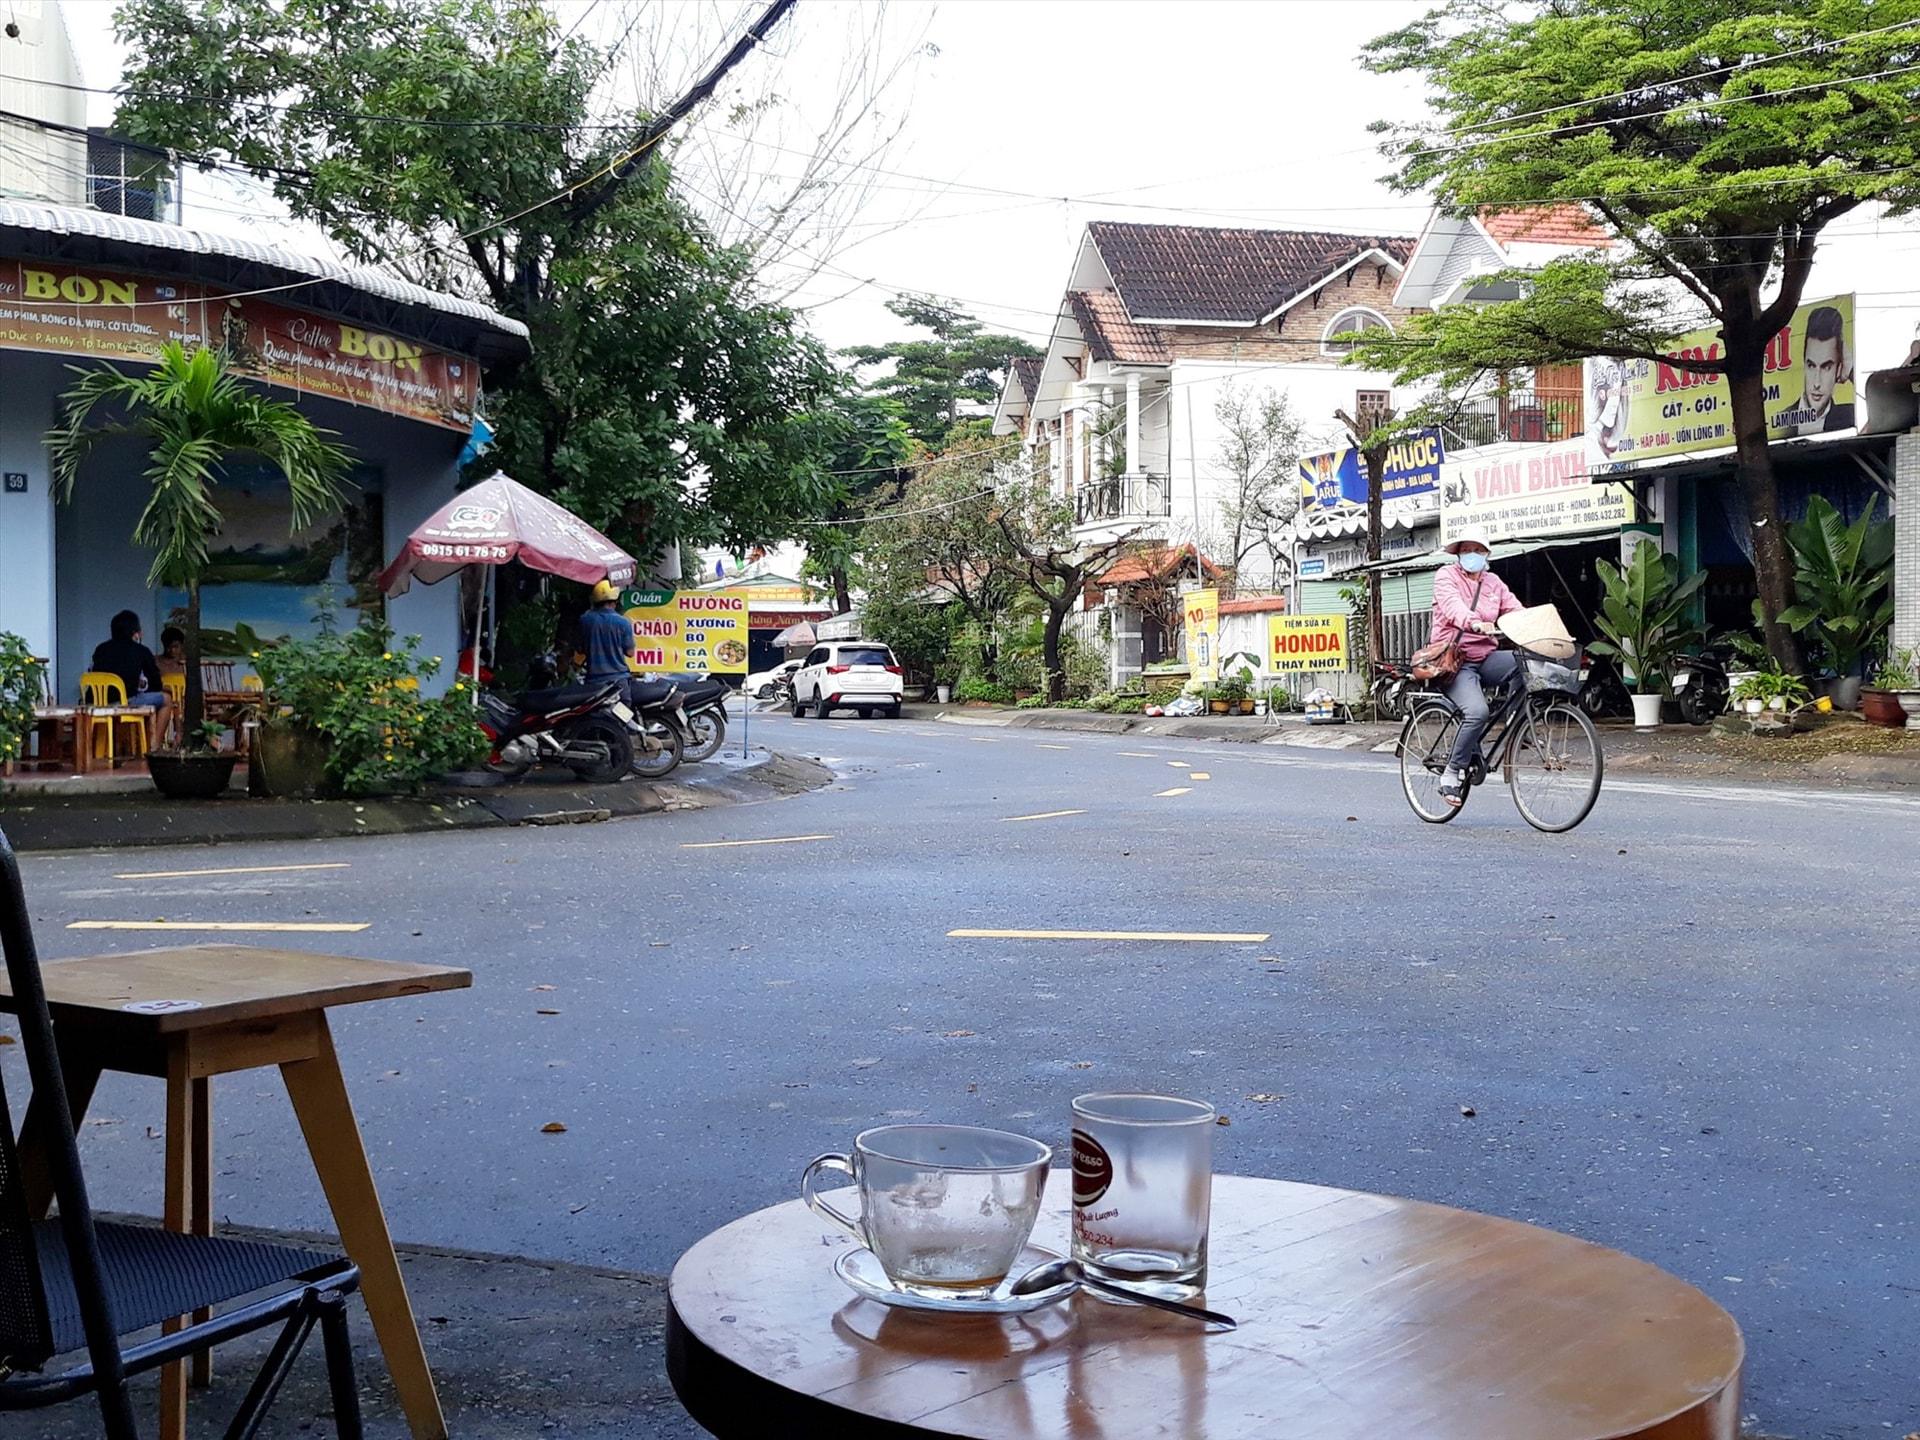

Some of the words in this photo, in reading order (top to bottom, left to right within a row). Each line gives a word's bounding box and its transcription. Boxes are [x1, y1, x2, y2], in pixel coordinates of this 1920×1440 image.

[23, 269, 138, 308] BON
[287, 318, 332, 349] Coffee
[338, 324, 422, 373] BON
[1474, 457, 1521, 499] VĂN
[1570, 499, 1591, 510] HONDA
[1597, 494, 1624, 507] YAMAHA
[422, 544, 453, 556] 0915
[456, 546, 470, 556] 61
[474, 546, 489, 557] 78
[491, 547, 507, 558] 78
[630, 591, 662, 605] Quán
[686, 618, 735, 628] XƯƠNG
[1321, 618, 1330, 627] XE
[1274, 632, 1341, 654] HONDA
[1275, 660, 1304, 670] THAY
